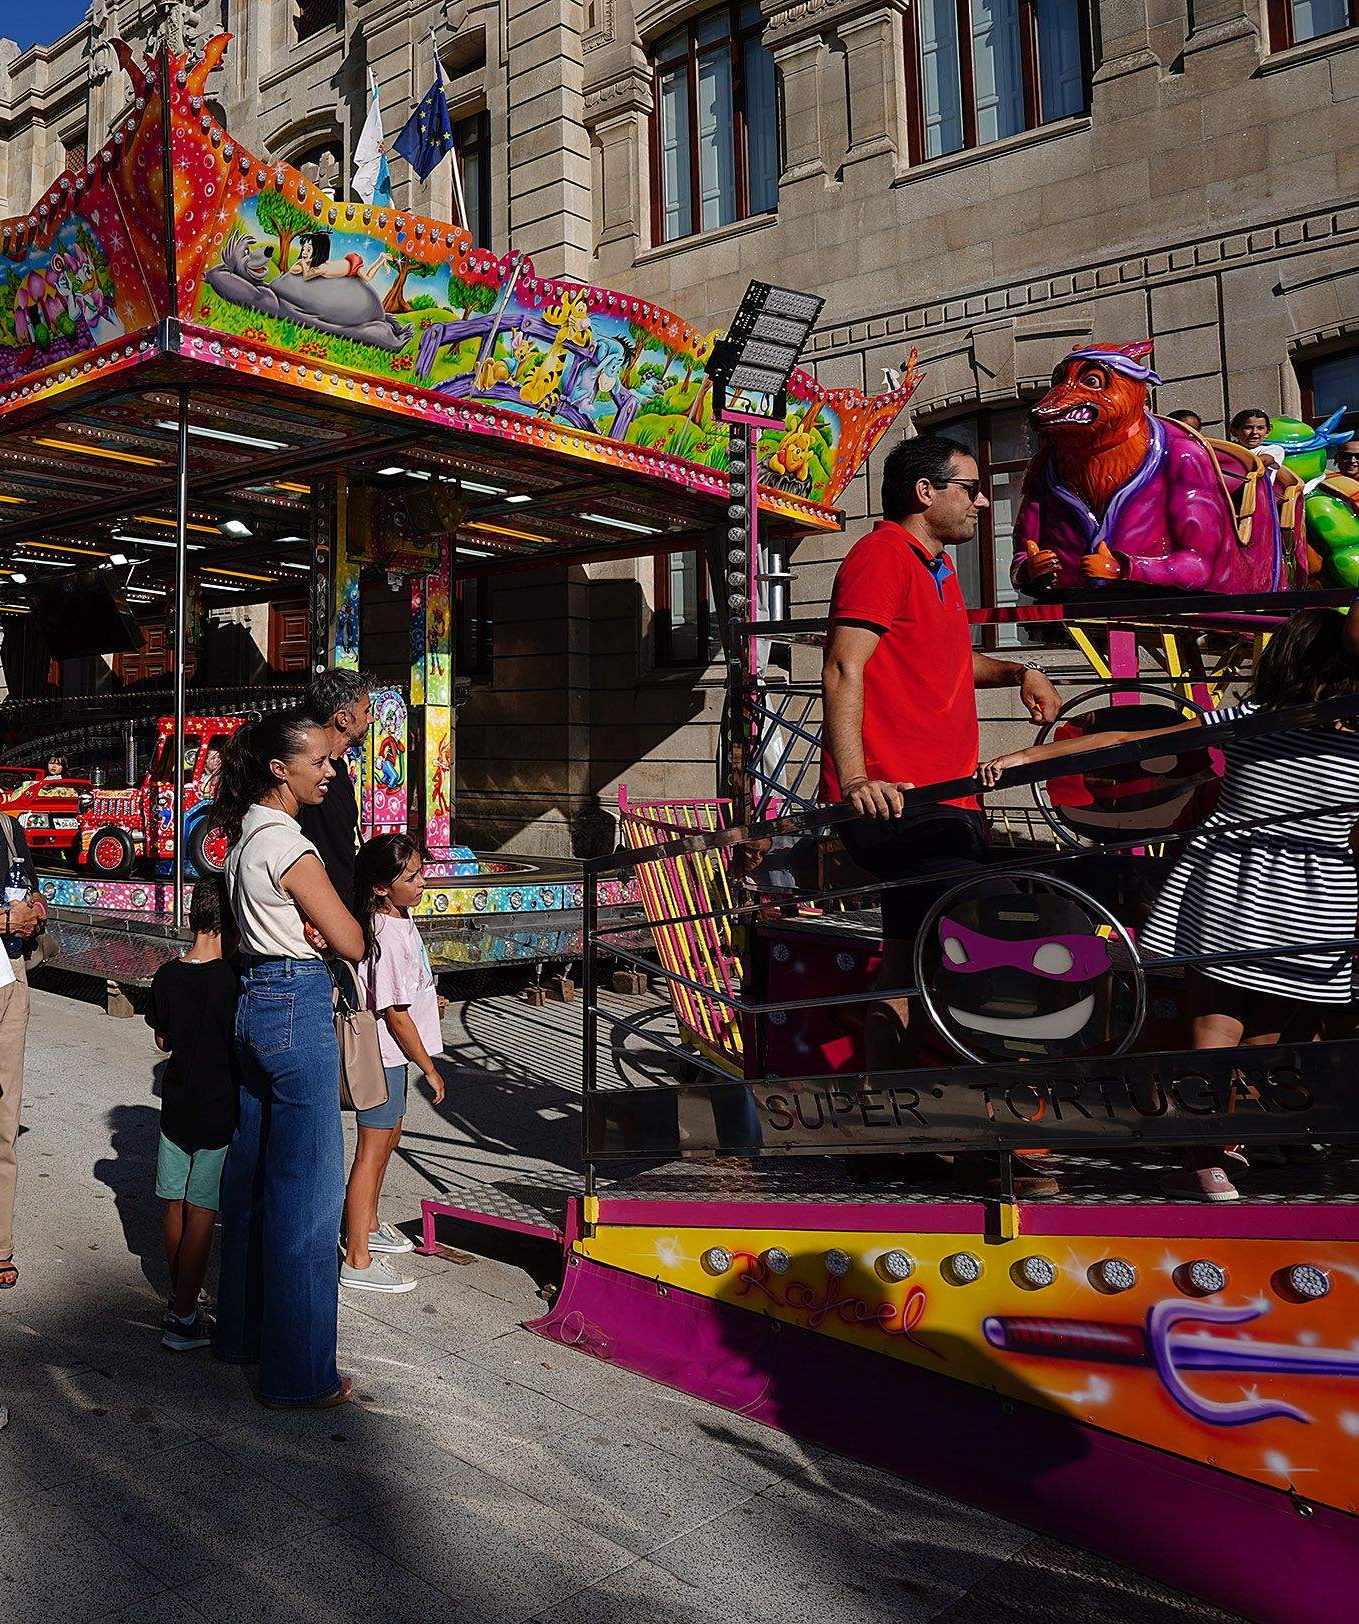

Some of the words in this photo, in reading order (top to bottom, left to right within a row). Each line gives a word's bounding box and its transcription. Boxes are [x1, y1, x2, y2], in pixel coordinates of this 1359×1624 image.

[766, 1087, 929, 1131] SUPER
[968, 1064, 1315, 1122] TORTUGAS
[732, 1252, 947, 1360] Rafael
